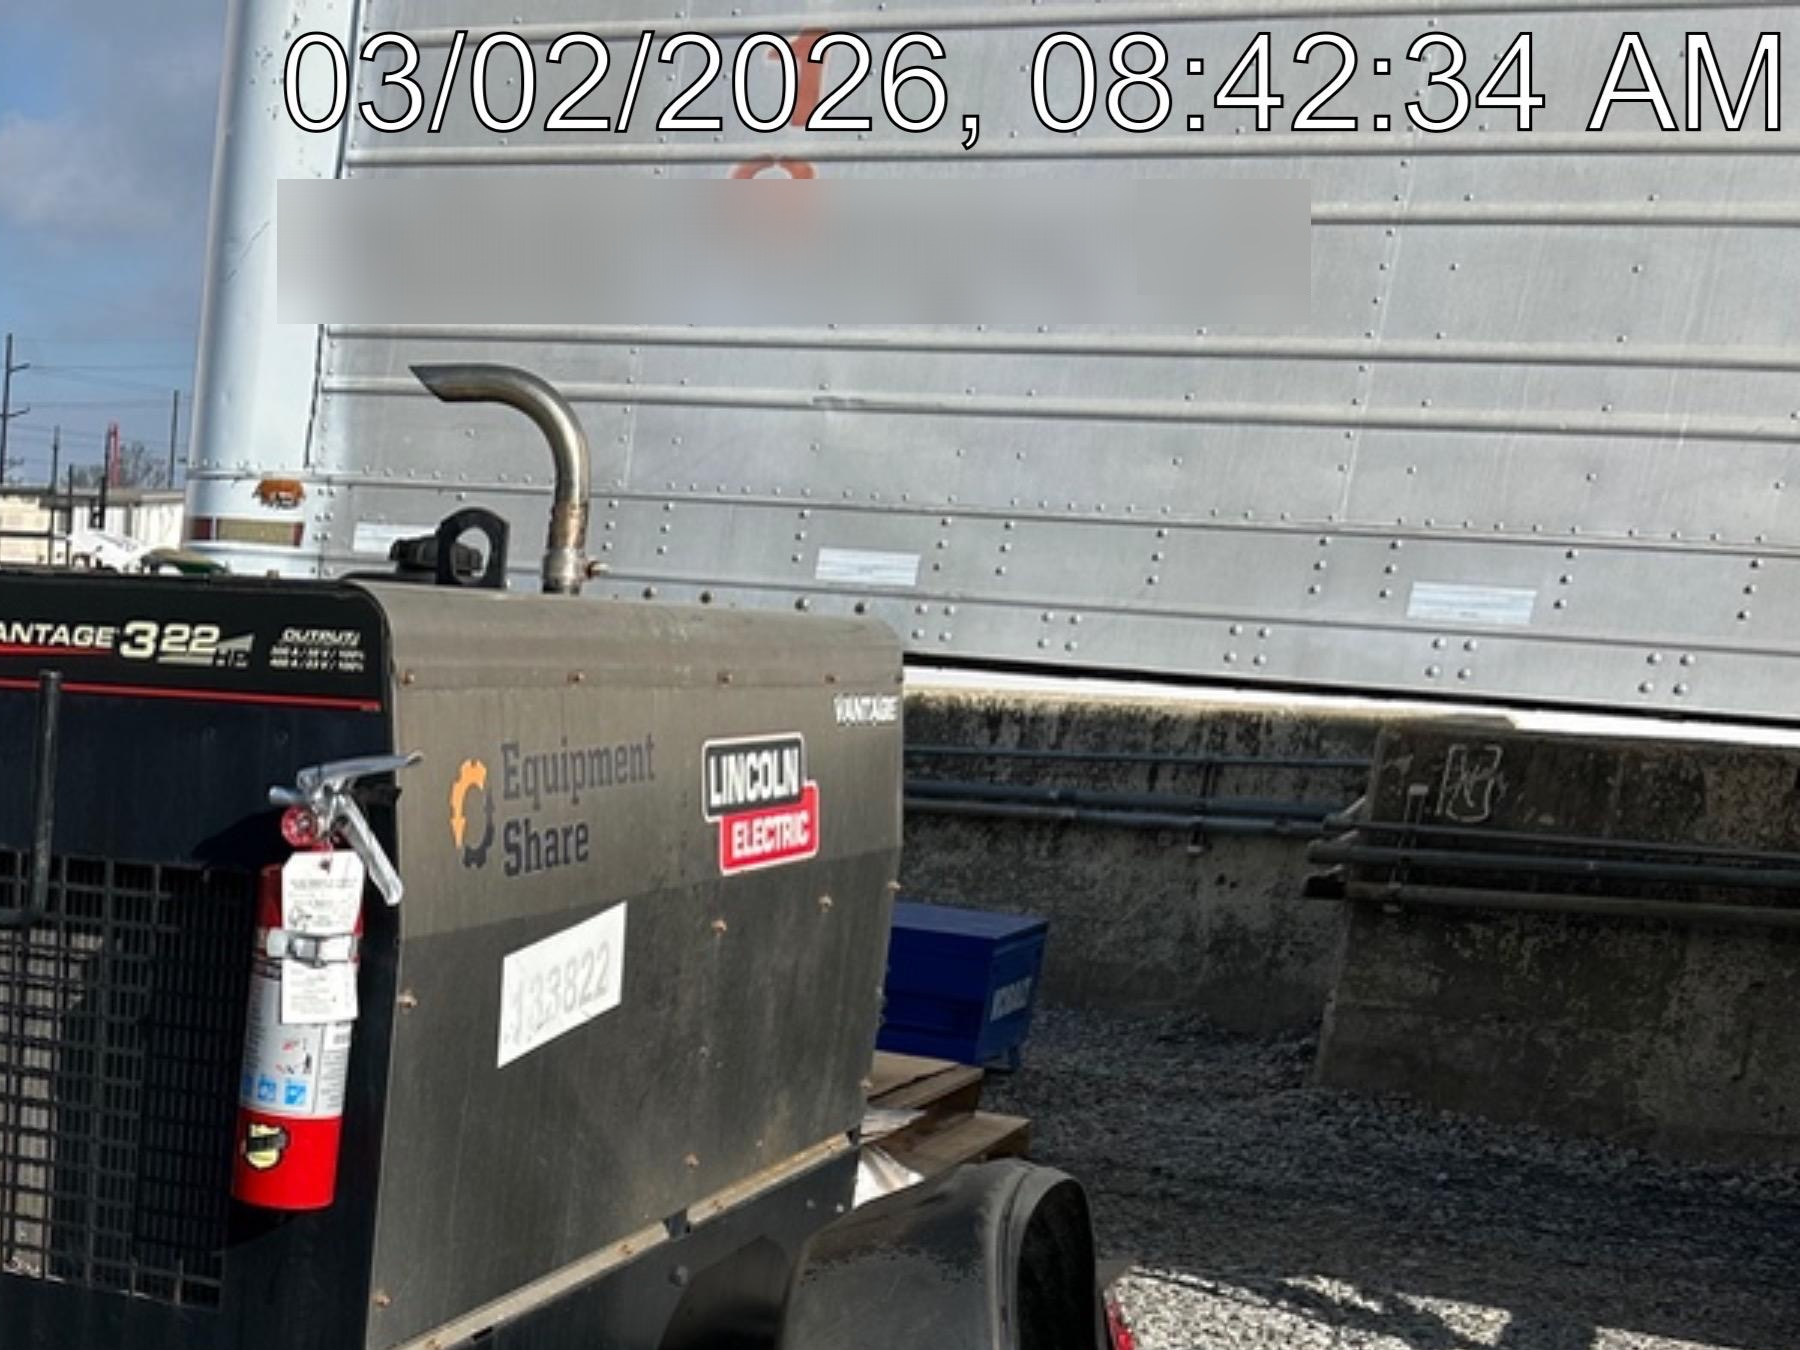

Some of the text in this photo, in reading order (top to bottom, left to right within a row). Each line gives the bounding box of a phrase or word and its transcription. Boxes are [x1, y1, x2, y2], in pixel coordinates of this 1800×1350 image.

[119, 620, 221, 659] 322
[833, 696, 898, 724] VANTAGE
[501, 733, 655, 811] Equipment
[709, 747, 801, 805] LINCOLN
[503, 817, 590, 877] Share
[731, 810, 809, 860] ELECTRIC
